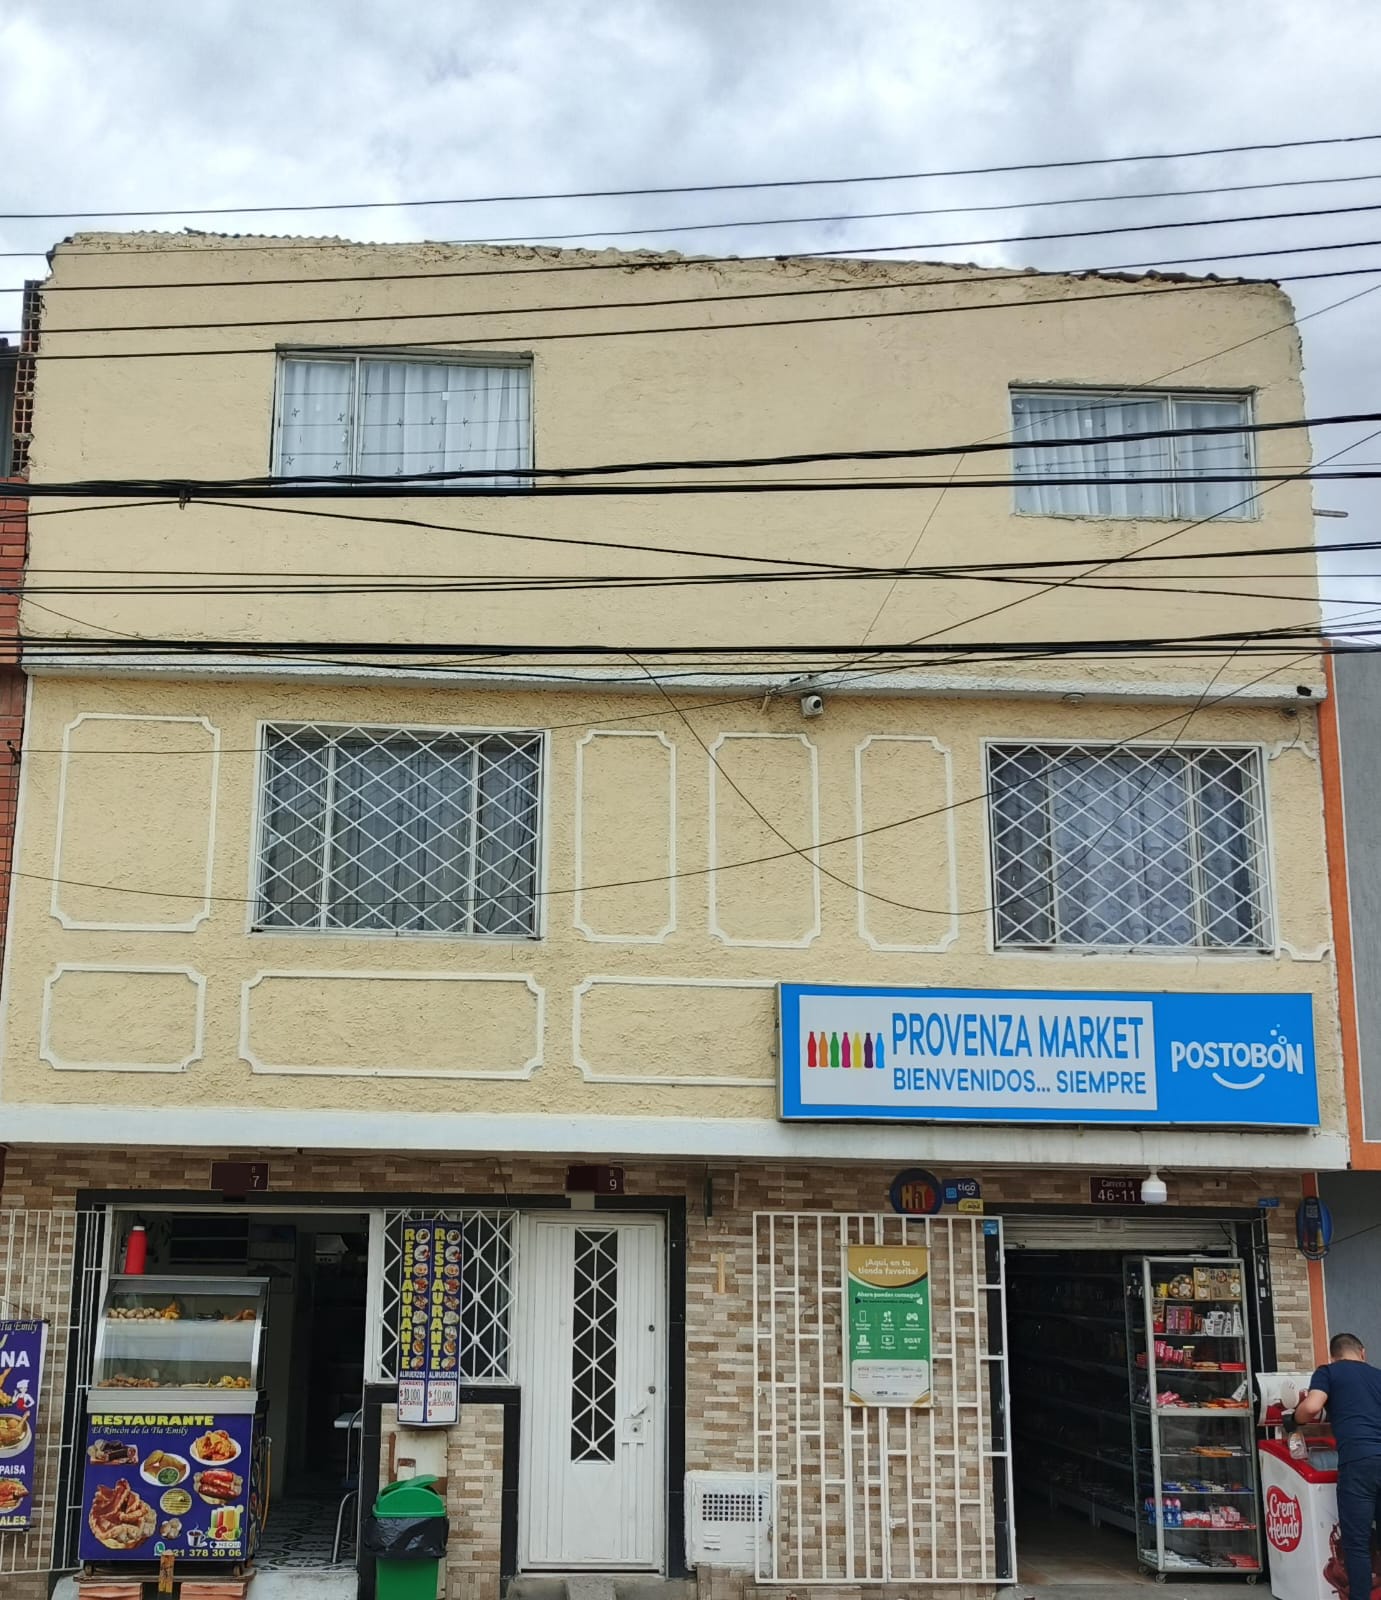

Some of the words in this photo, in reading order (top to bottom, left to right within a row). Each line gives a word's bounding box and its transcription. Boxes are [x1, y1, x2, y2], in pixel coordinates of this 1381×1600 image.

[892, 1012, 1033, 1057] PROVENZA
[1038, 1015, 1144, 1059] MARKET
[893, 1067, 1051, 1092] BIENVENIDOS...
[1056, 1070, 1147, 1094] SIEMPRE
[252, 1175, 260, 1188] 7
[609, 1178, 617, 1191] 9
[1097, 1189, 1136, 1202] 46-11
[858, 1267, 883, 1275] tienda
[401, 1228, 416, 1369] RESTAURANTE
[430, 1228, 446, 1369] RESTAURANTE
[91, 1414, 215, 1426] RESTAURANTE
[130, 1426, 140, 1434] de
[1269, 1493, 1297, 1519] Crem
[1268, 1515, 1299, 1546] Helado
[189, 1549, 209, 1557] 378
[212, 1549, 225, 1557] 30
[228, 1549, 242, 1557] 06
